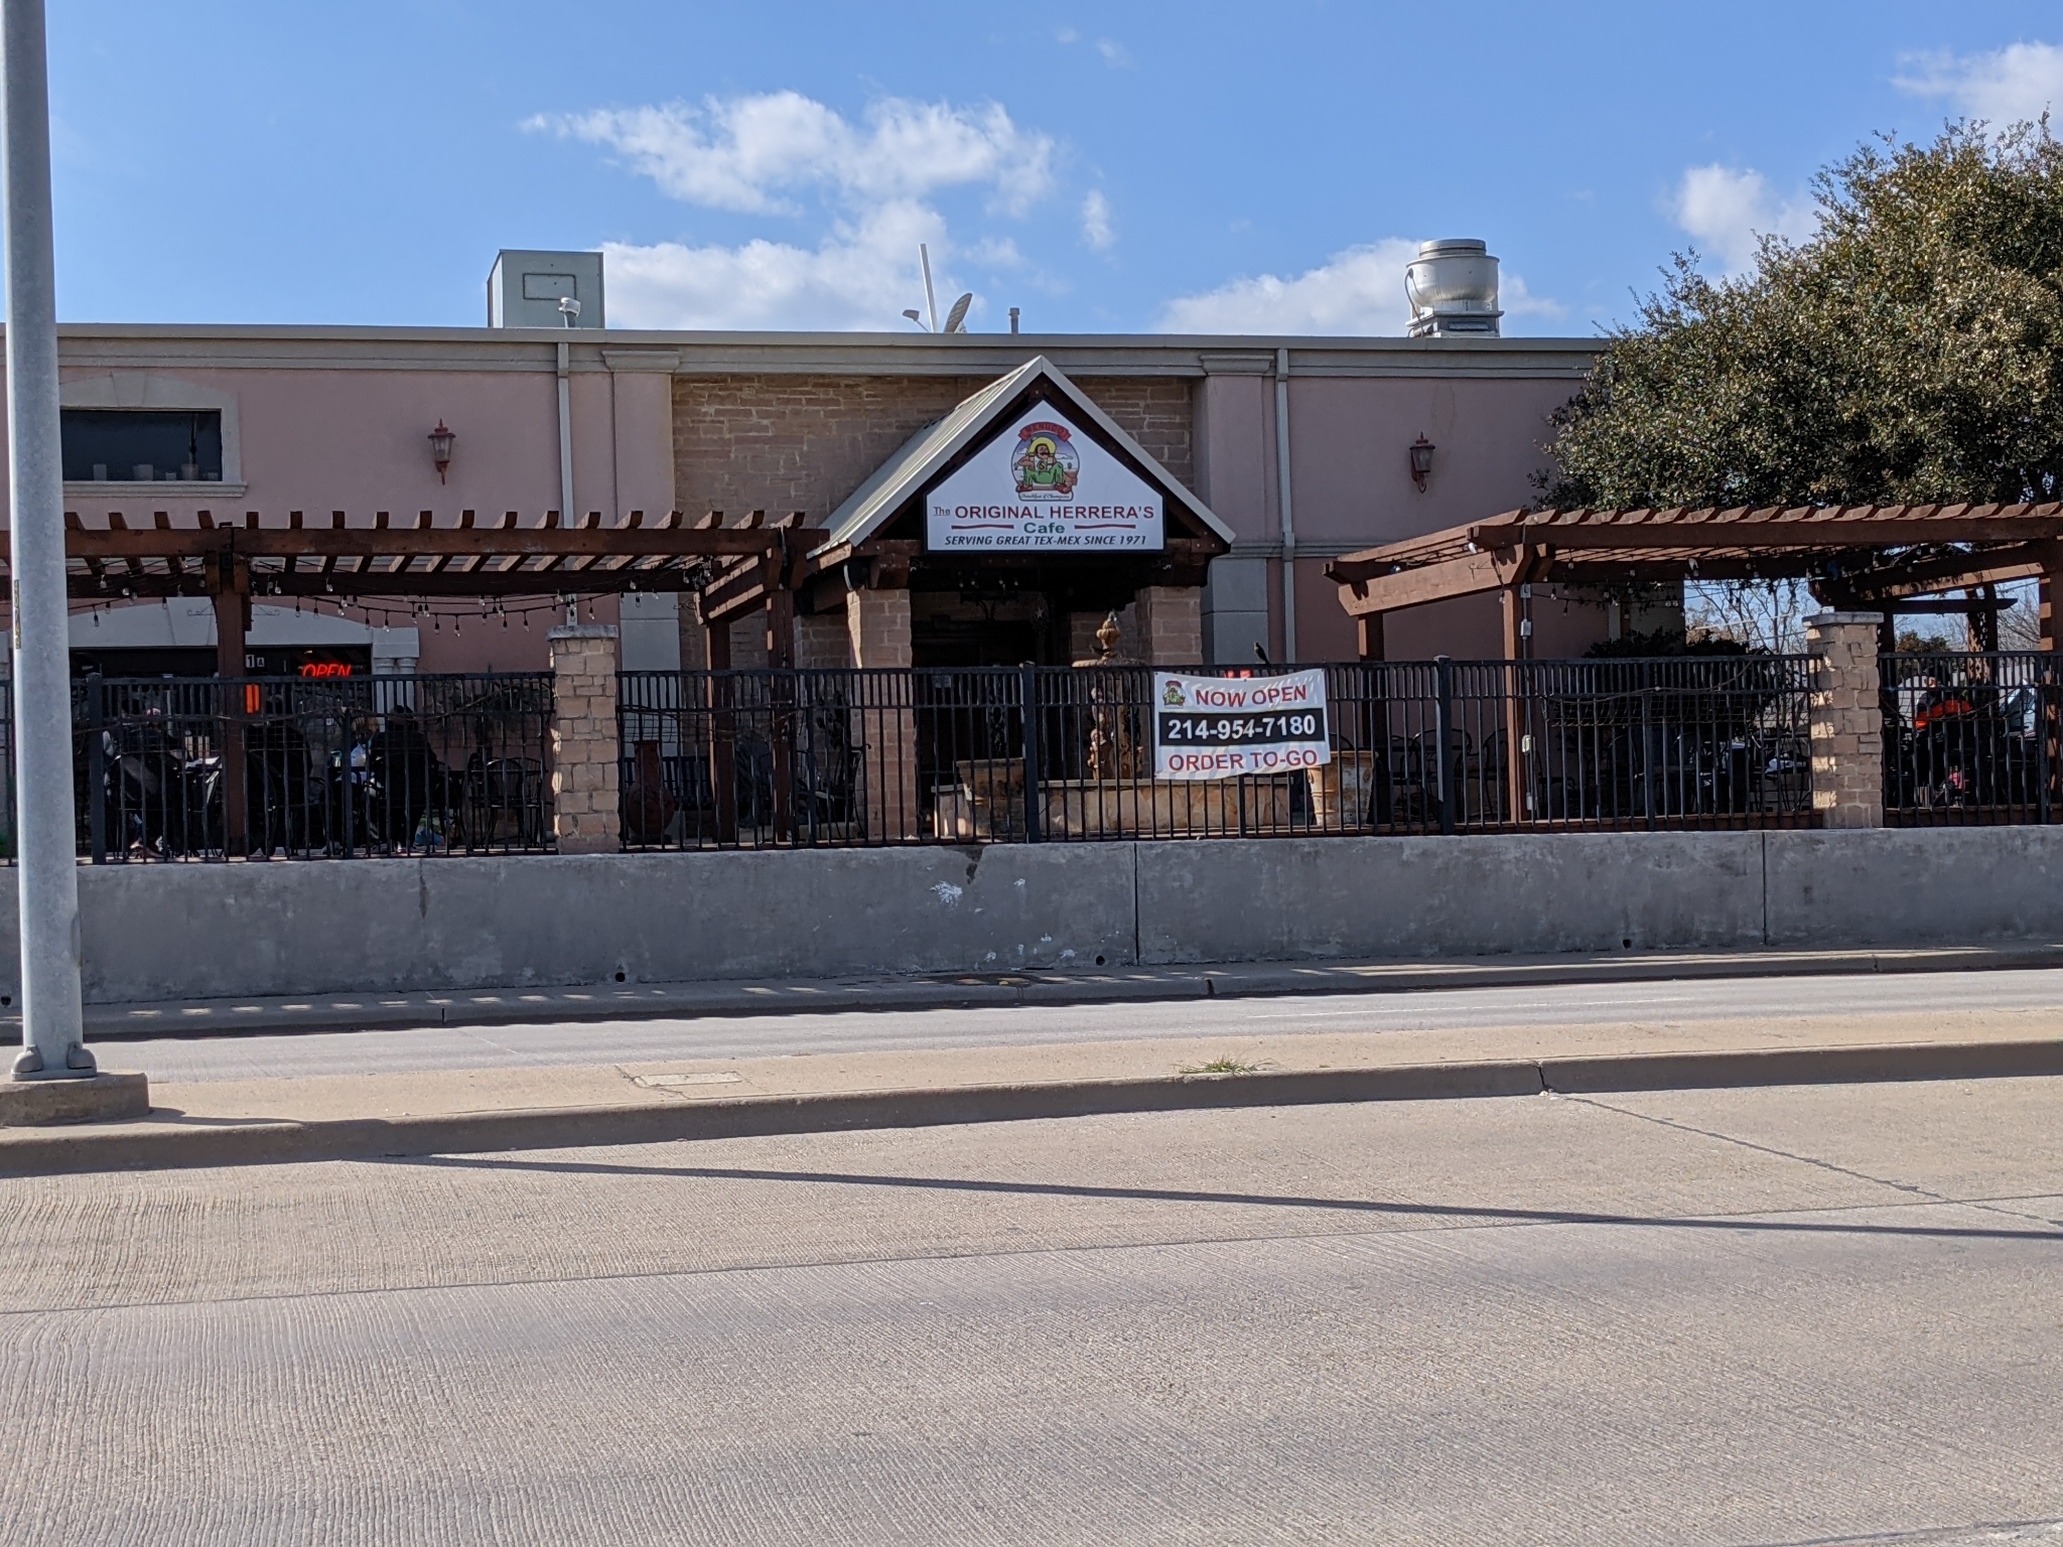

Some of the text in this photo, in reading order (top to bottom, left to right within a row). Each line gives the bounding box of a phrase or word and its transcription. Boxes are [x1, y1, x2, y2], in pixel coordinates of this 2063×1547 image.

[934, 505, 1154, 519] The ORIGINAL HERRERA'S
[1023, 522, 1065, 534] Cafe
[945, 536, 1146, 546] SERVING GREAT TEX-MEX SINCE 1971
[302, 663, 351, 677] OPEN
[1196, 684, 1307, 708] NOW OPEN
[1168, 715, 1316, 740] 214-954-7180
[1168, 749, 1318, 771] ORDER TO-GO
